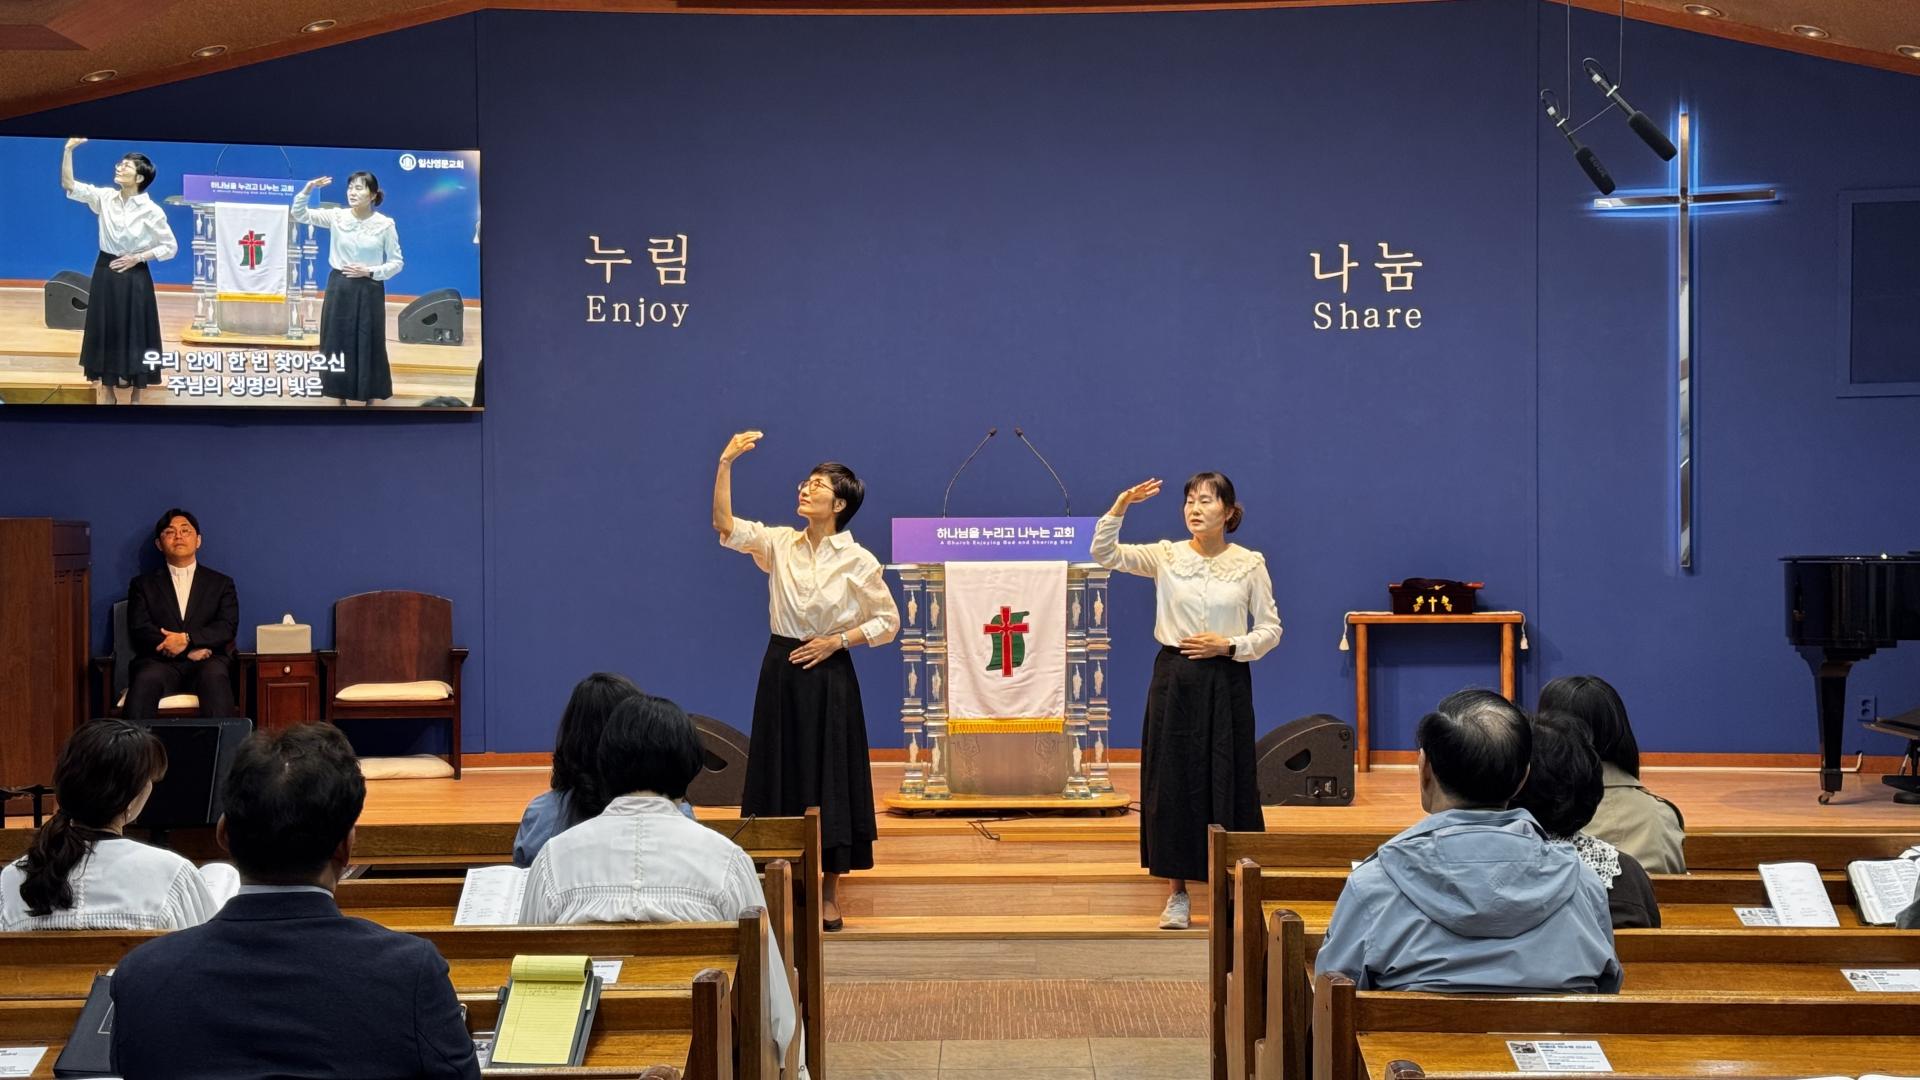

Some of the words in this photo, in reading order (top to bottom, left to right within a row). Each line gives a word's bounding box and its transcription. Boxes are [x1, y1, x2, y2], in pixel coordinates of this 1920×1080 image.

[586, 295, 690, 327] Enjoy
[1313, 301, 1422, 330] Share
[142, 351, 180, 371] 우리
[185, 351, 223, 372] 안에
[227, 351, 246, 371] 한
[251, 351, 270, 371] 번
[274, 351, 346, 373] 찾아오신
[167, 376, 222, 396] 주님의
[228, 376, 282, 396] 생명의
[288, 376, 324, 397] 빛은
[937, 526, 980, 539] 하나님을
[983, 527, 1015, 539] 누리고
[1018, 527, 1050, 539] 나누는
[1053, 526, 1075, 538] 교회
